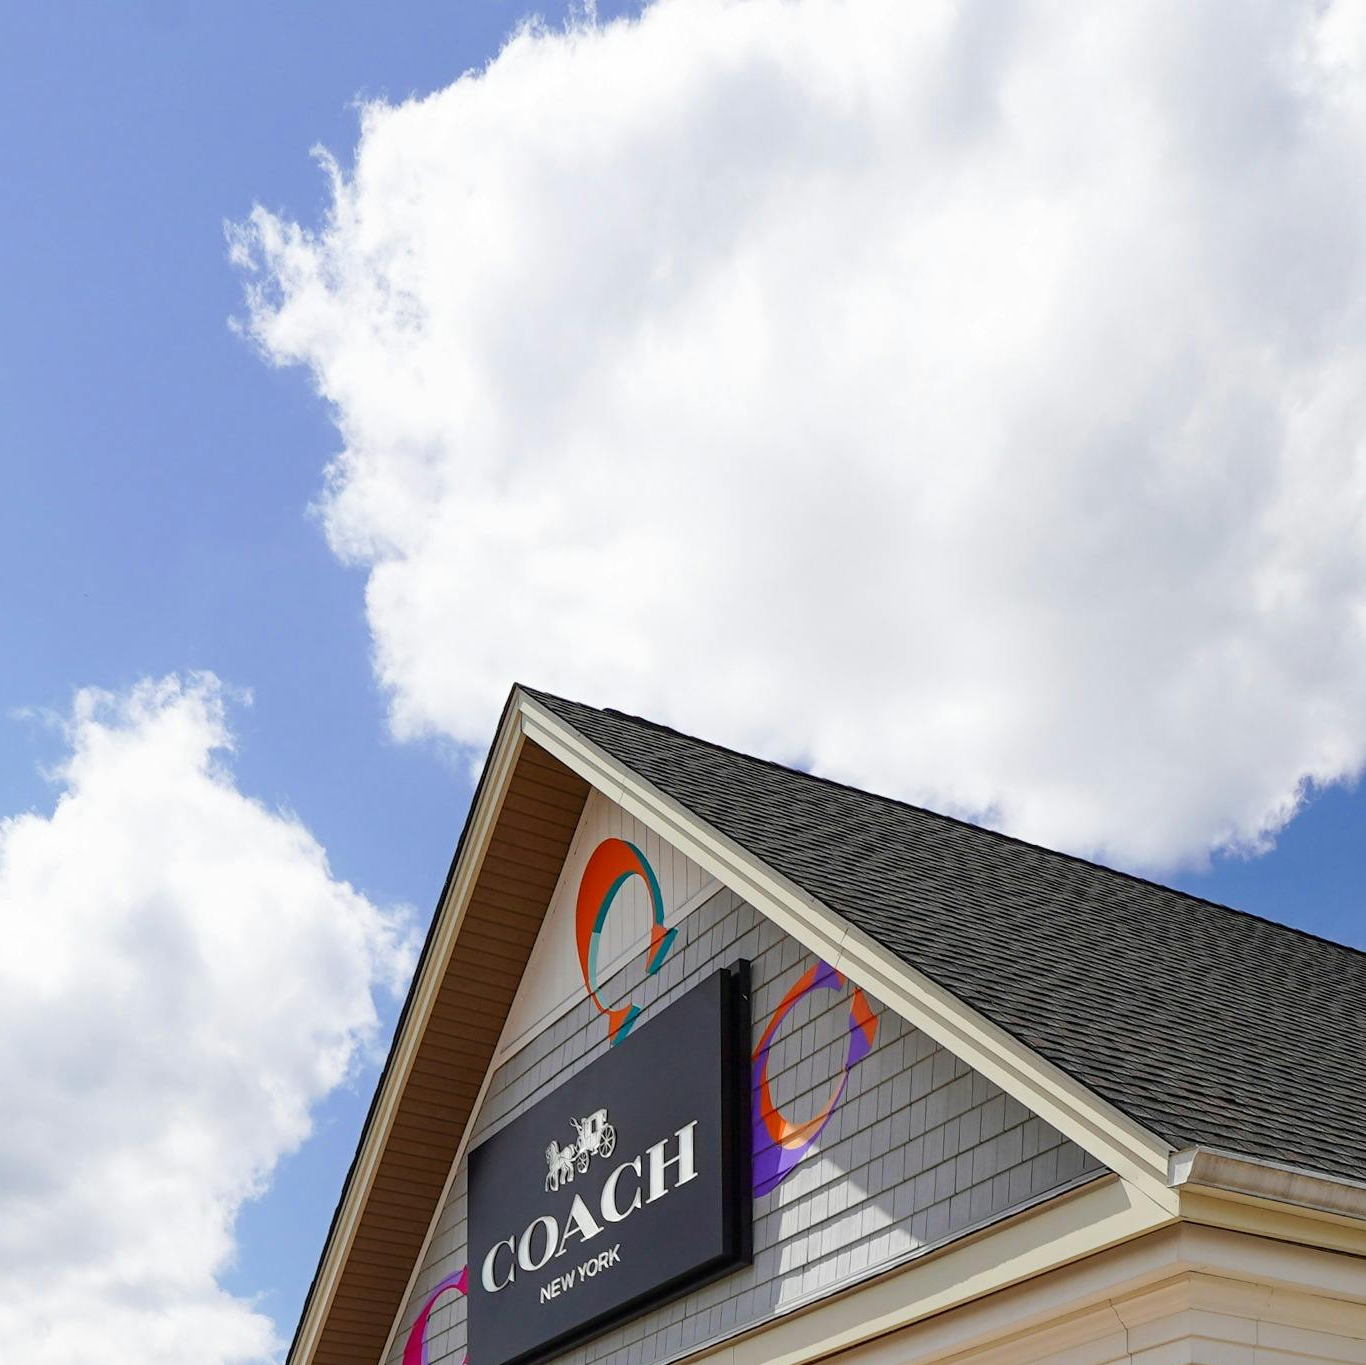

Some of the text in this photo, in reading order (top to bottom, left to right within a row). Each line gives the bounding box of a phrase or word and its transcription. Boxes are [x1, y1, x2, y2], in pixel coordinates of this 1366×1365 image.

[481, 1119, 699, 1293] COACH
[539, 1243, 622, 1304] NEW YORK
